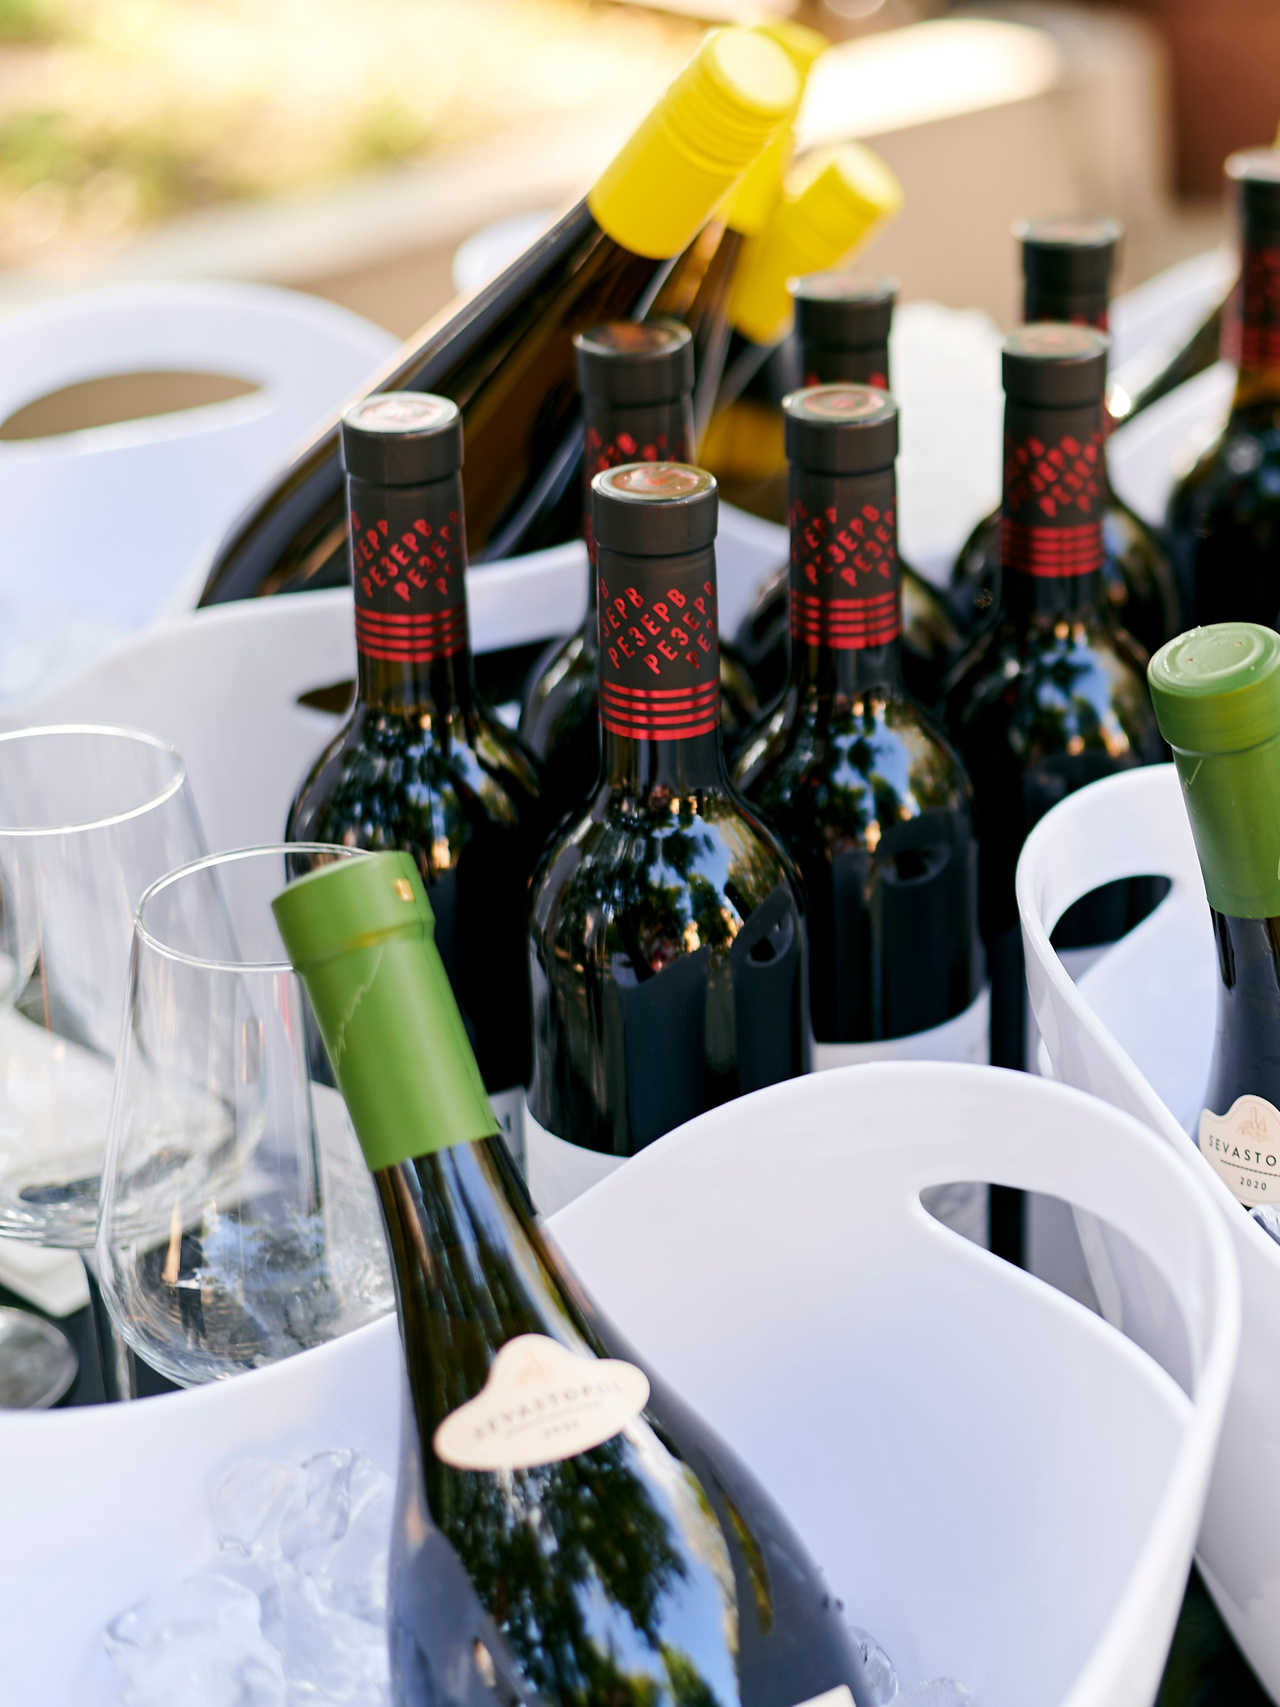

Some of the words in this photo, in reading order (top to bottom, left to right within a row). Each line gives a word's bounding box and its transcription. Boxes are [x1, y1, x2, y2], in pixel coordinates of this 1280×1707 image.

[361, 517, 433, 599] РЕЗЕРВ
[607, 588, 687, 670] РЕЗЕРВ
[1239, 1176, 1268, 1191] 2020
